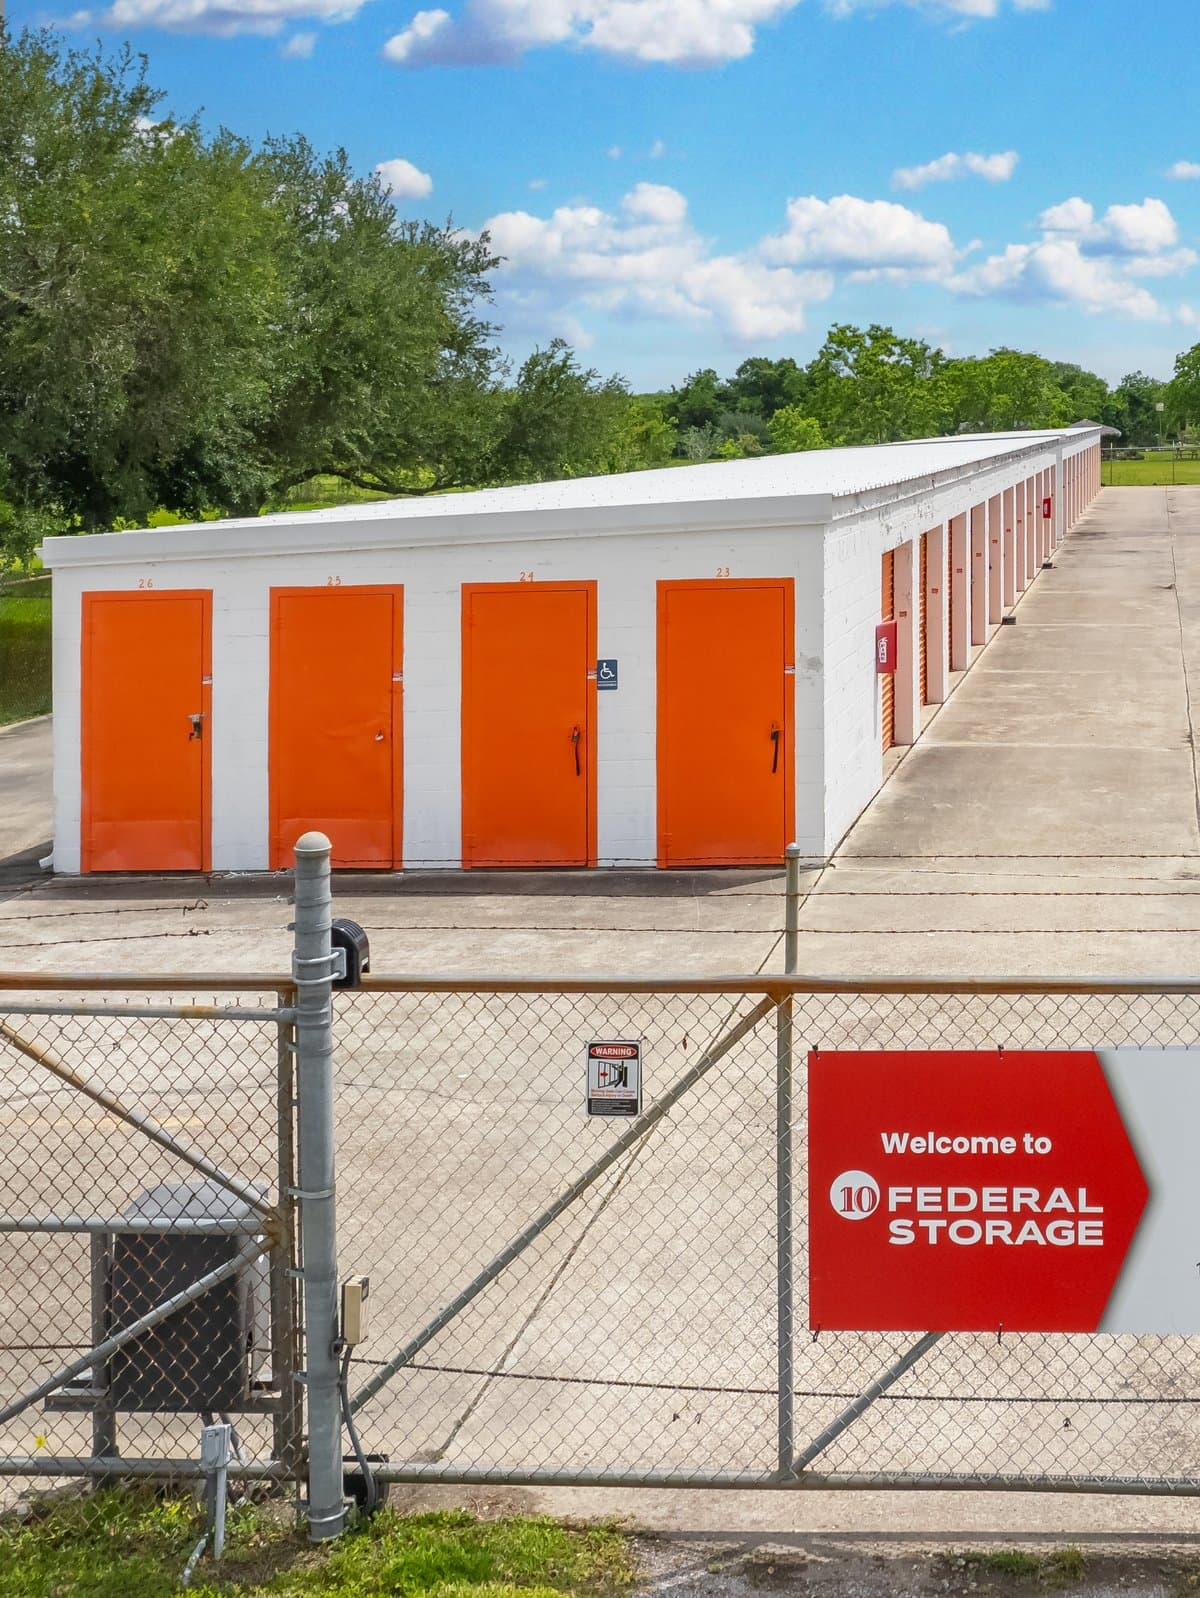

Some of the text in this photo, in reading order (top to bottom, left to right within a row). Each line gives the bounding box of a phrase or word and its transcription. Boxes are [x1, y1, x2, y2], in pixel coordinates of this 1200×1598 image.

[519, 571, 534, 582] 24
[716, 567, 730, 578] 23
[138, 578, 153, 589] 26
[327, 575, 342, 586] 25
[595, 1047, 632, 1056] WARNING
[881, 1131, 1052, 1154] Welcome to
[888, 1187, 1104, 1213] FEDERAL
[888, 1218, 1104, 1246] STORAGE
